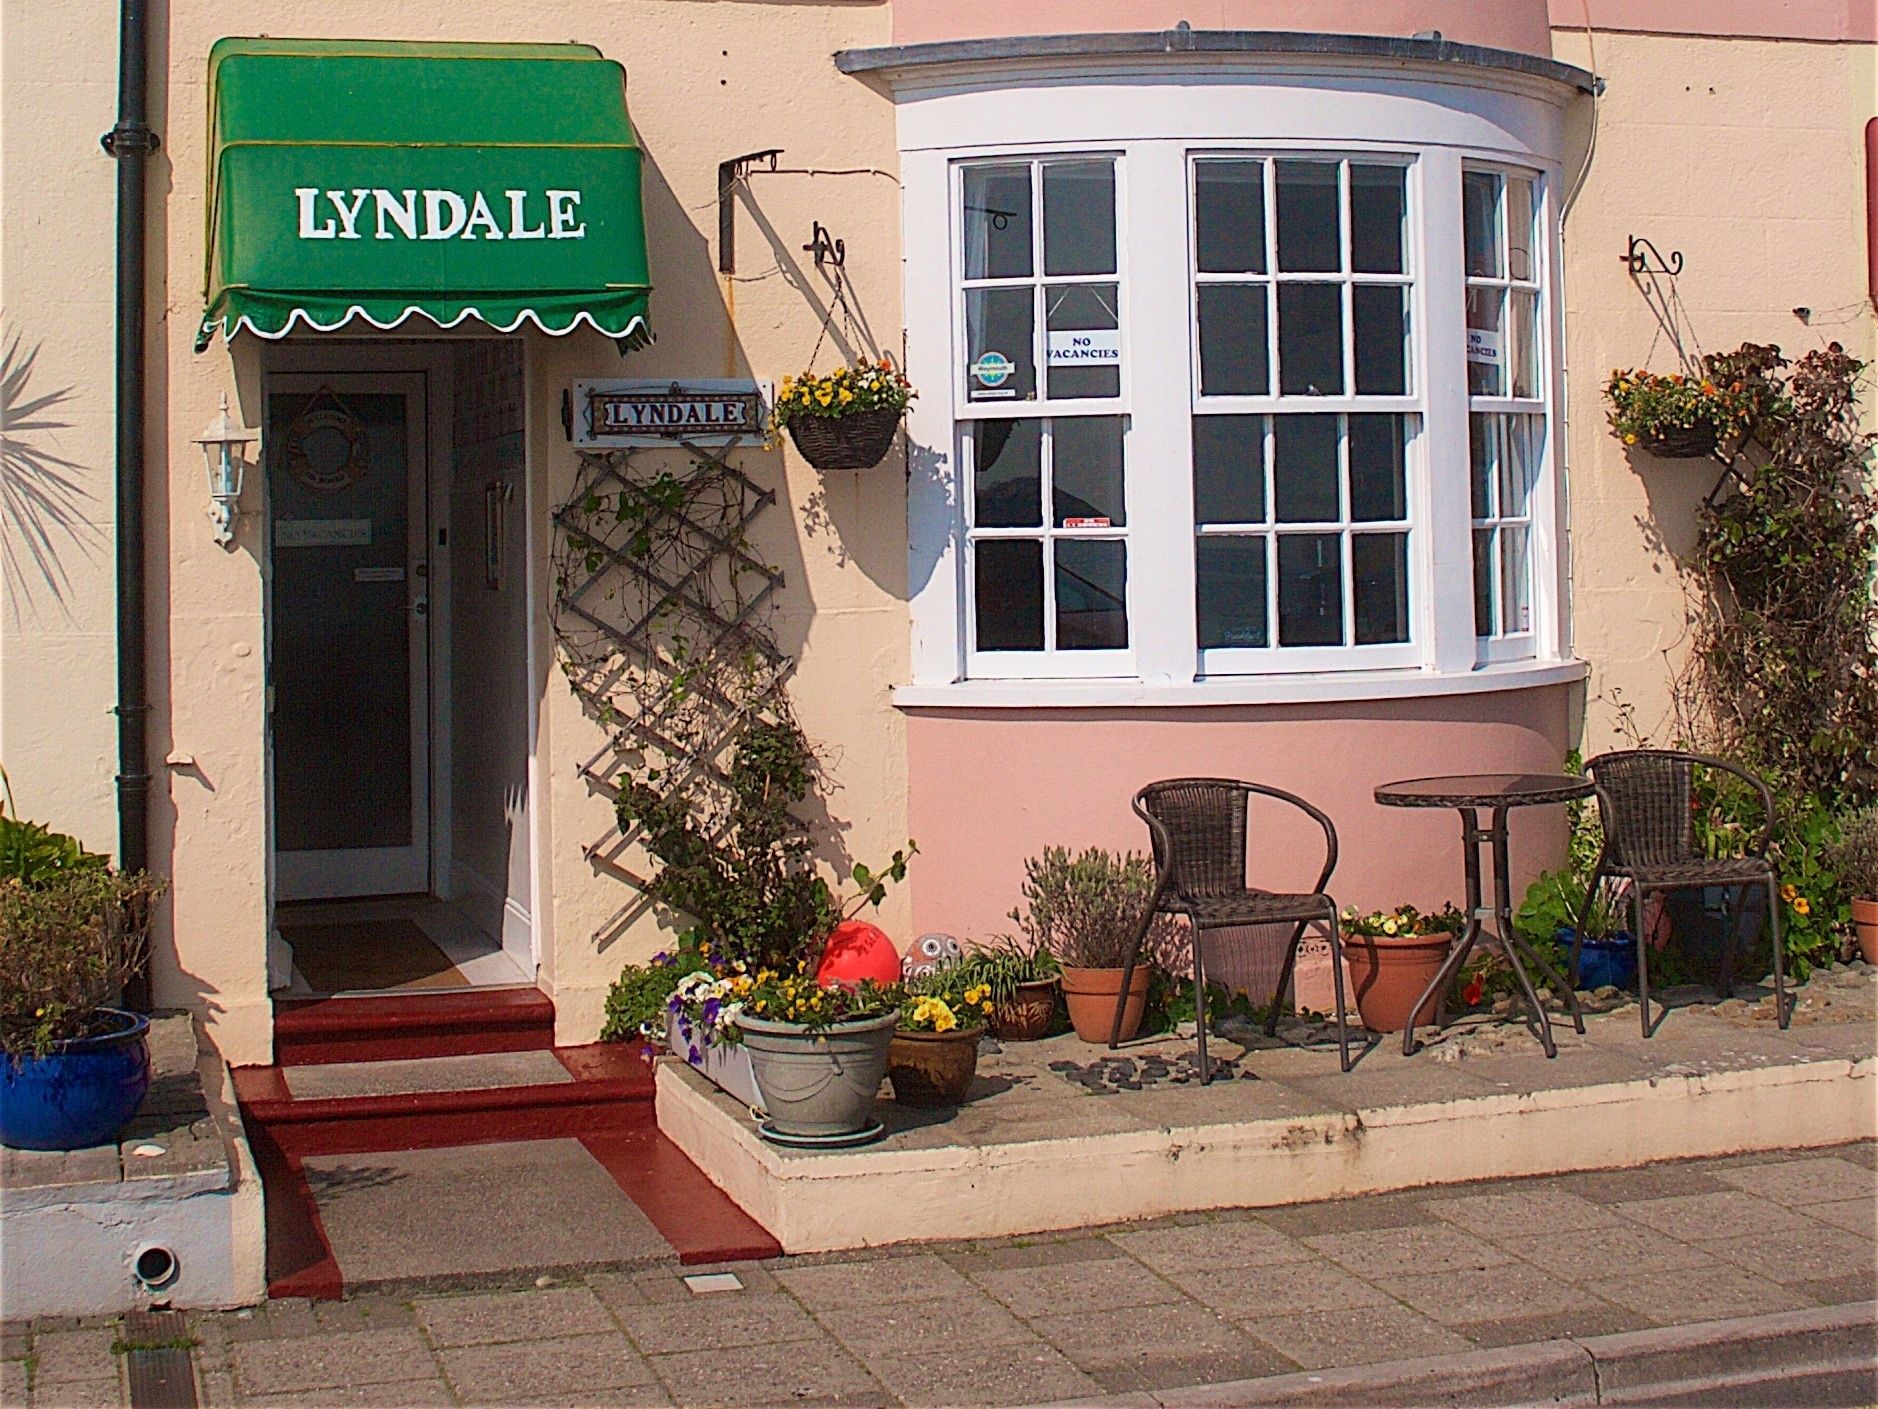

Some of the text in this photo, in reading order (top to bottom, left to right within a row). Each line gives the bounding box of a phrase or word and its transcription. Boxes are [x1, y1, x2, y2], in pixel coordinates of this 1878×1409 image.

[295, 188, 586, 240] LYNDALE
[1072, 337, 1091, 347] NO
[1470, 334, 1482, 344] NO
[1047, 349, 1119, 358] VACANCIES
[613, 403, 738, 424] LYNDALE
